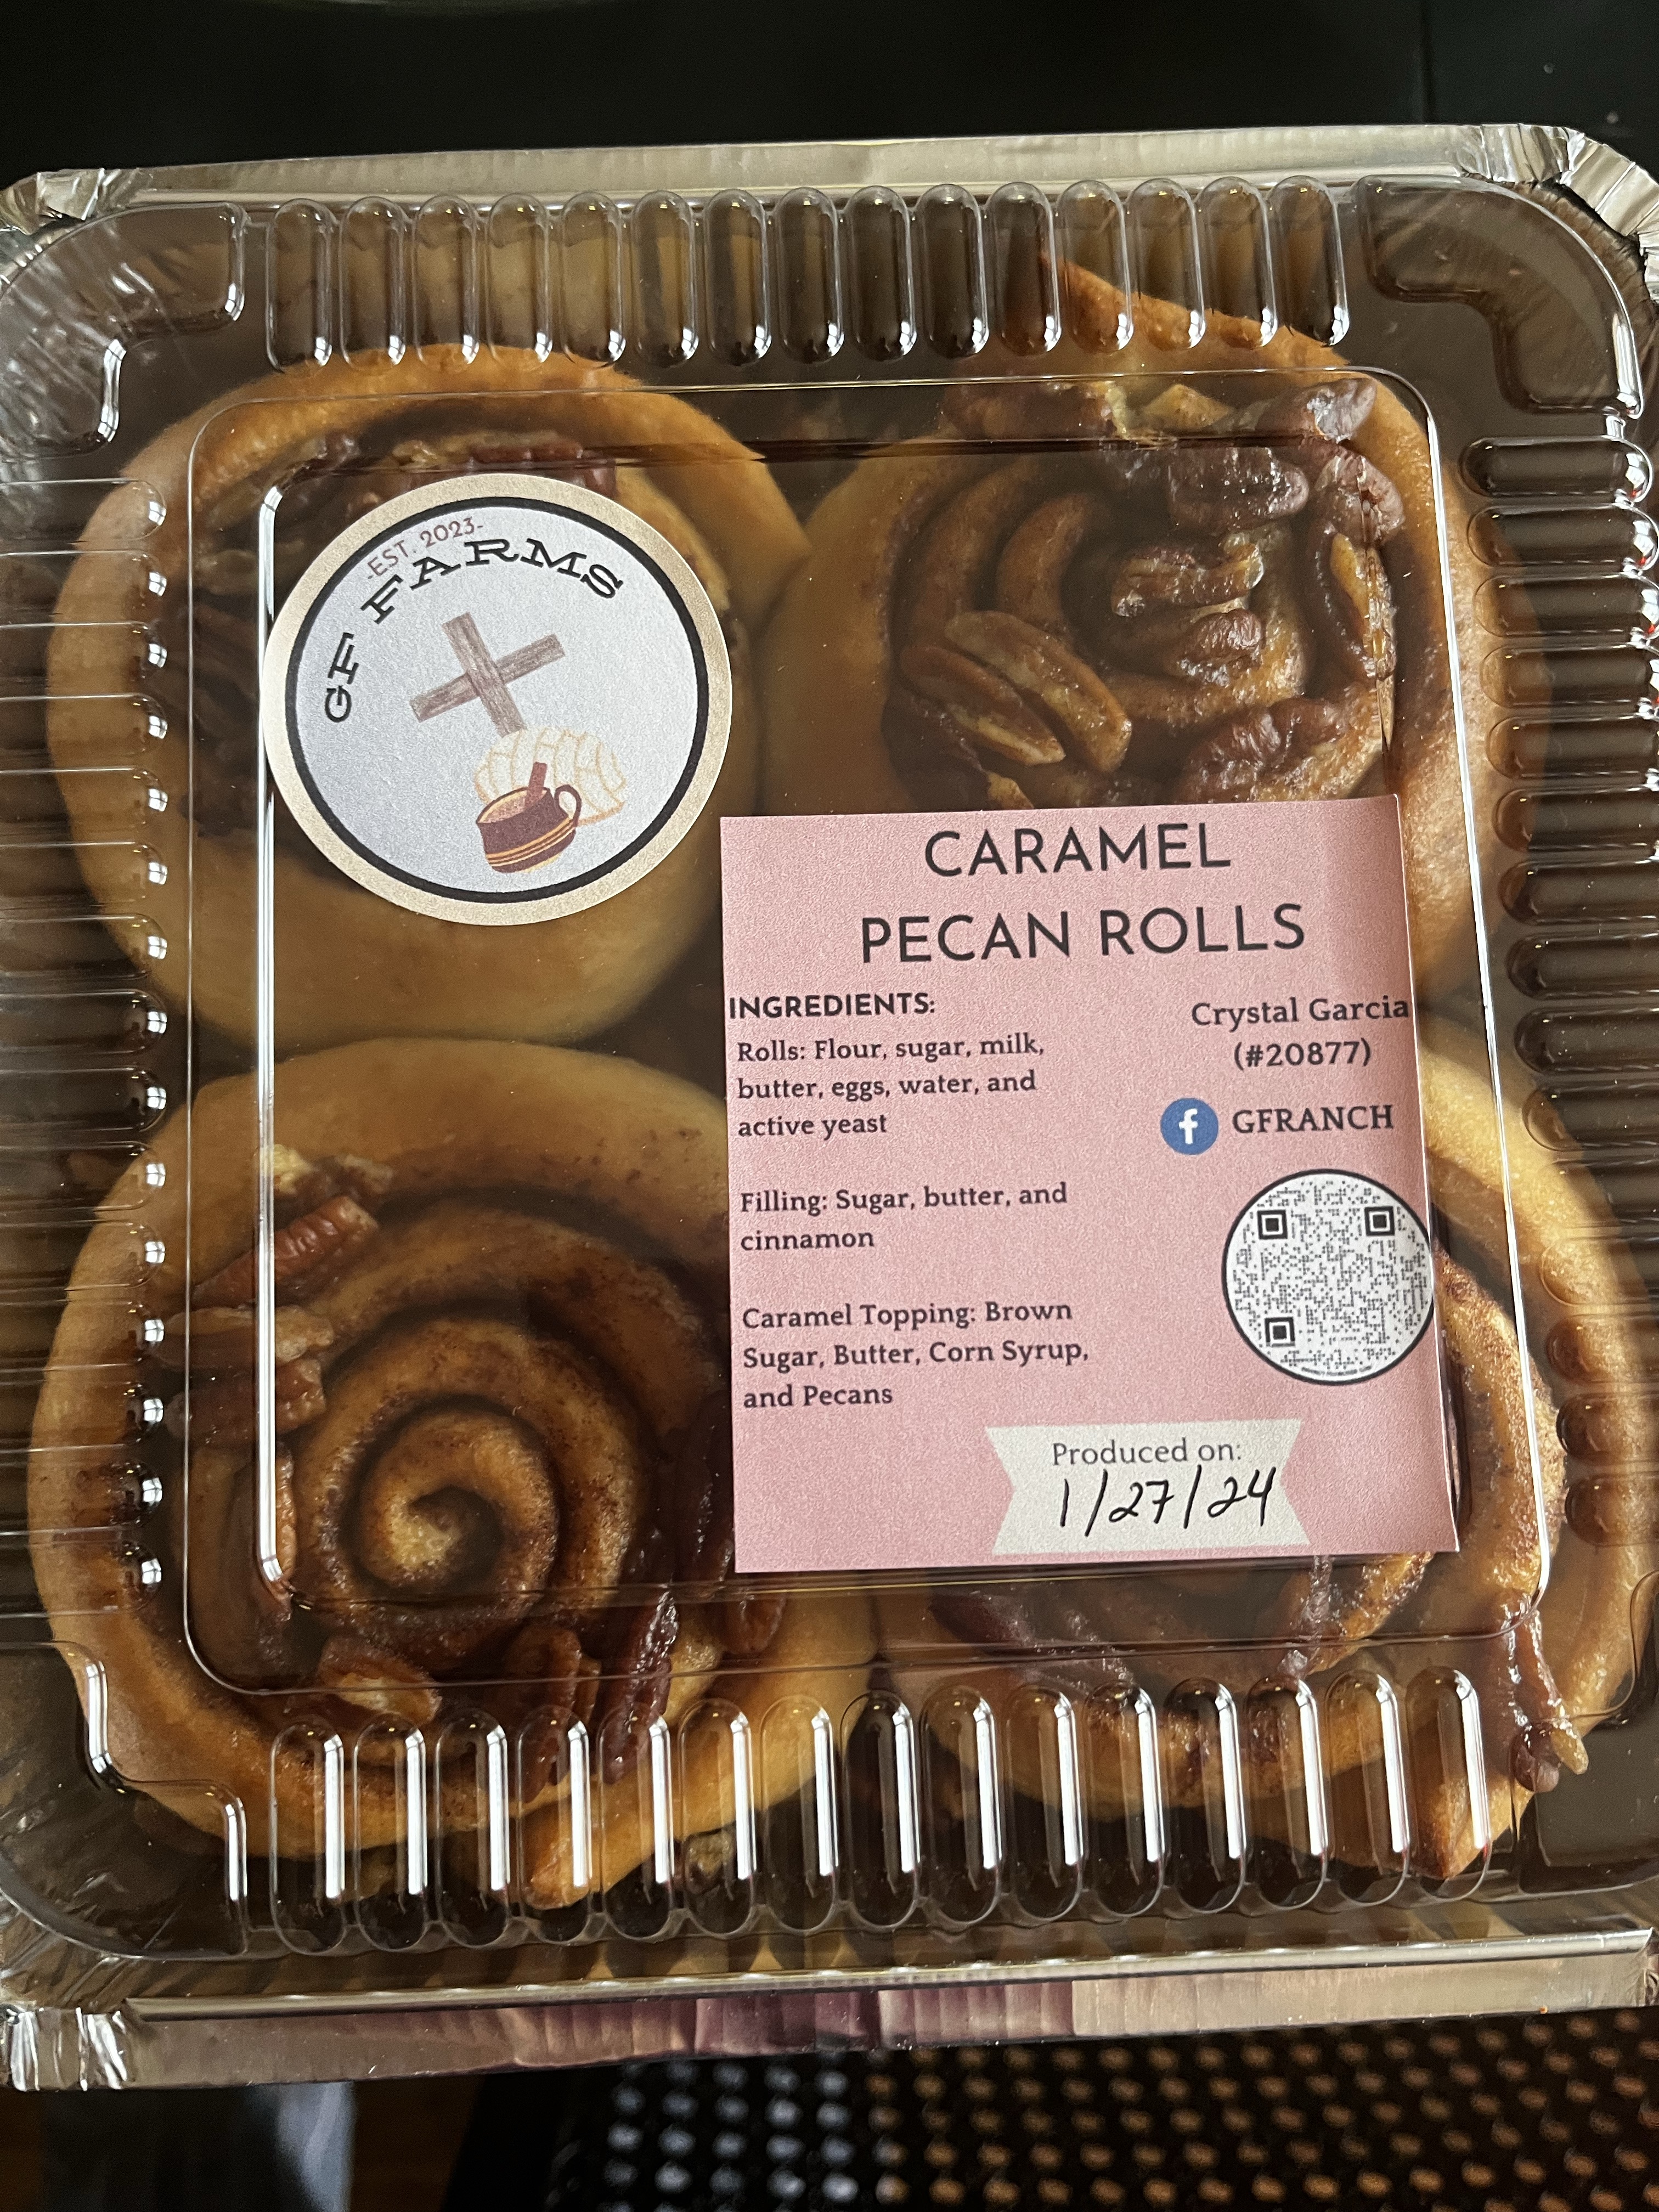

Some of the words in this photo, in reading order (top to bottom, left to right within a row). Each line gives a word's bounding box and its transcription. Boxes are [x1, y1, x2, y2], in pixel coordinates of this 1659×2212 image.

[324, 632, 359, 723] GF
[360, 538, 624, 624] FARMS
[925, 822, 1231, 877] CARAMEL
[862, 911, 1070, 963] PECAN
[1100, 904, 1305, 956] ROLLS
[730, 992, 935, 1019] INGREDIENTS:
[1192, 997, 1299, 1032] Crystal
[1310, 995, 1409, 1022] Garcia
[738, 1040, 805, 1062] Rolls:
[815, 1039, 887, 1060] Flour,
[895, 1040, 970, 1063] sugar,
[979, 1032, 1044, 1056] milk,
[1234, 1038, 1371, 1071] (#20877)
[738, 1078, 823, 1099] butter,
[831, 1080, 890, 1102] eggs,
[899, 1074, 980, 1095] water,
[988, 1069, 1035, 1091] and
[738, 1115, 814, 1137] active
[822, 1114, 887, 1140] yeast
[1233, 1104, 1393, 1133] GFRANCH
[741, 1190, 827, 1216] Filling:
[836, 1189, 915, 1215] Sugar,
[924, 1186, 1011, 1208] butter,
[1019, 1182, 1067, 1204] and
[741, 1229, 874, 1251] cinnamon
[743, 1304, 851, 1329] Caramel
[860, 1302, 975, 1331] Topping:
[985, 1302, 1072, 1322] Brown
[743, 1347, 824, 1374] Sugar,
[834, 1344, 920, 1365] Butter,
[929, 1342, 994, 1363] Corn
[1002, 1340, 1088, 1367] Syrup,
[743, 1384, 793, 1408] and
[803, 1385, 893, 1407] Pecans
[1053, 1437, 1188, 1466] Produced
[1198, 1443, 1242, 1462] on:
[1060, 1464, 1276, 1537] 1/27/24
